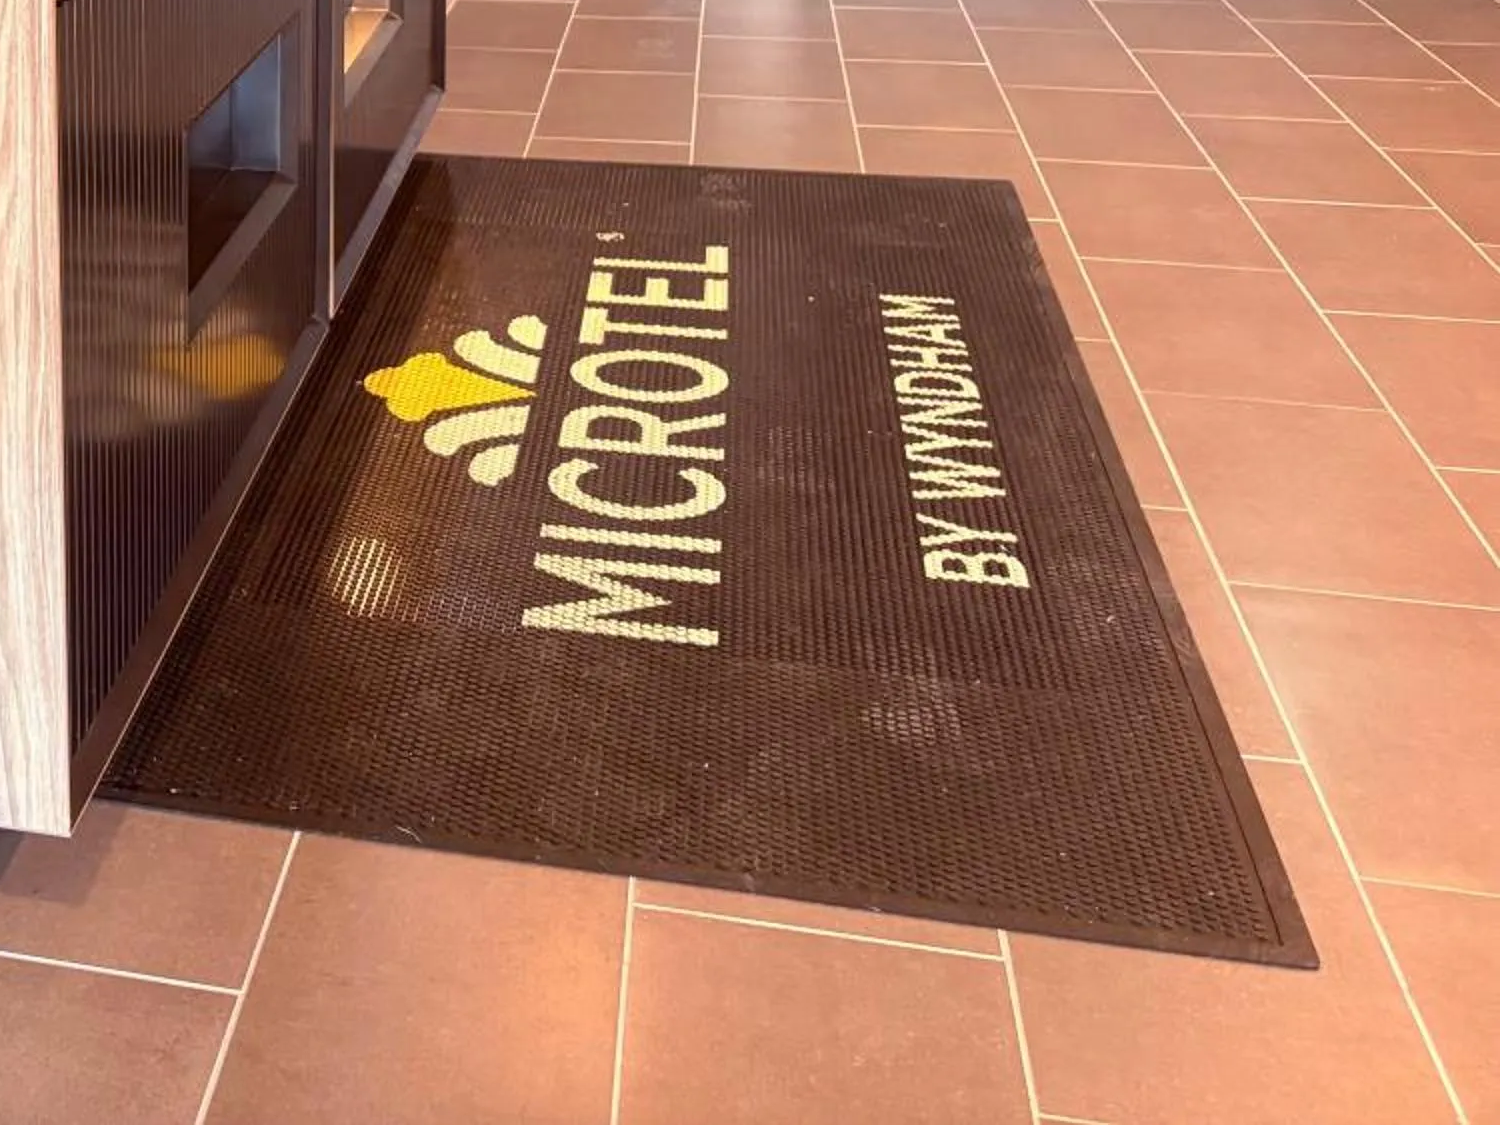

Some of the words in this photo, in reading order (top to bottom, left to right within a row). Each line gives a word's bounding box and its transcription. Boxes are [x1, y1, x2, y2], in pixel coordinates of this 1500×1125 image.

[521, 244, 729, 647] MICROTEL
[879, 293, 1007, 502] WYNDHAM
[915, 512, 1031, 589] BY
